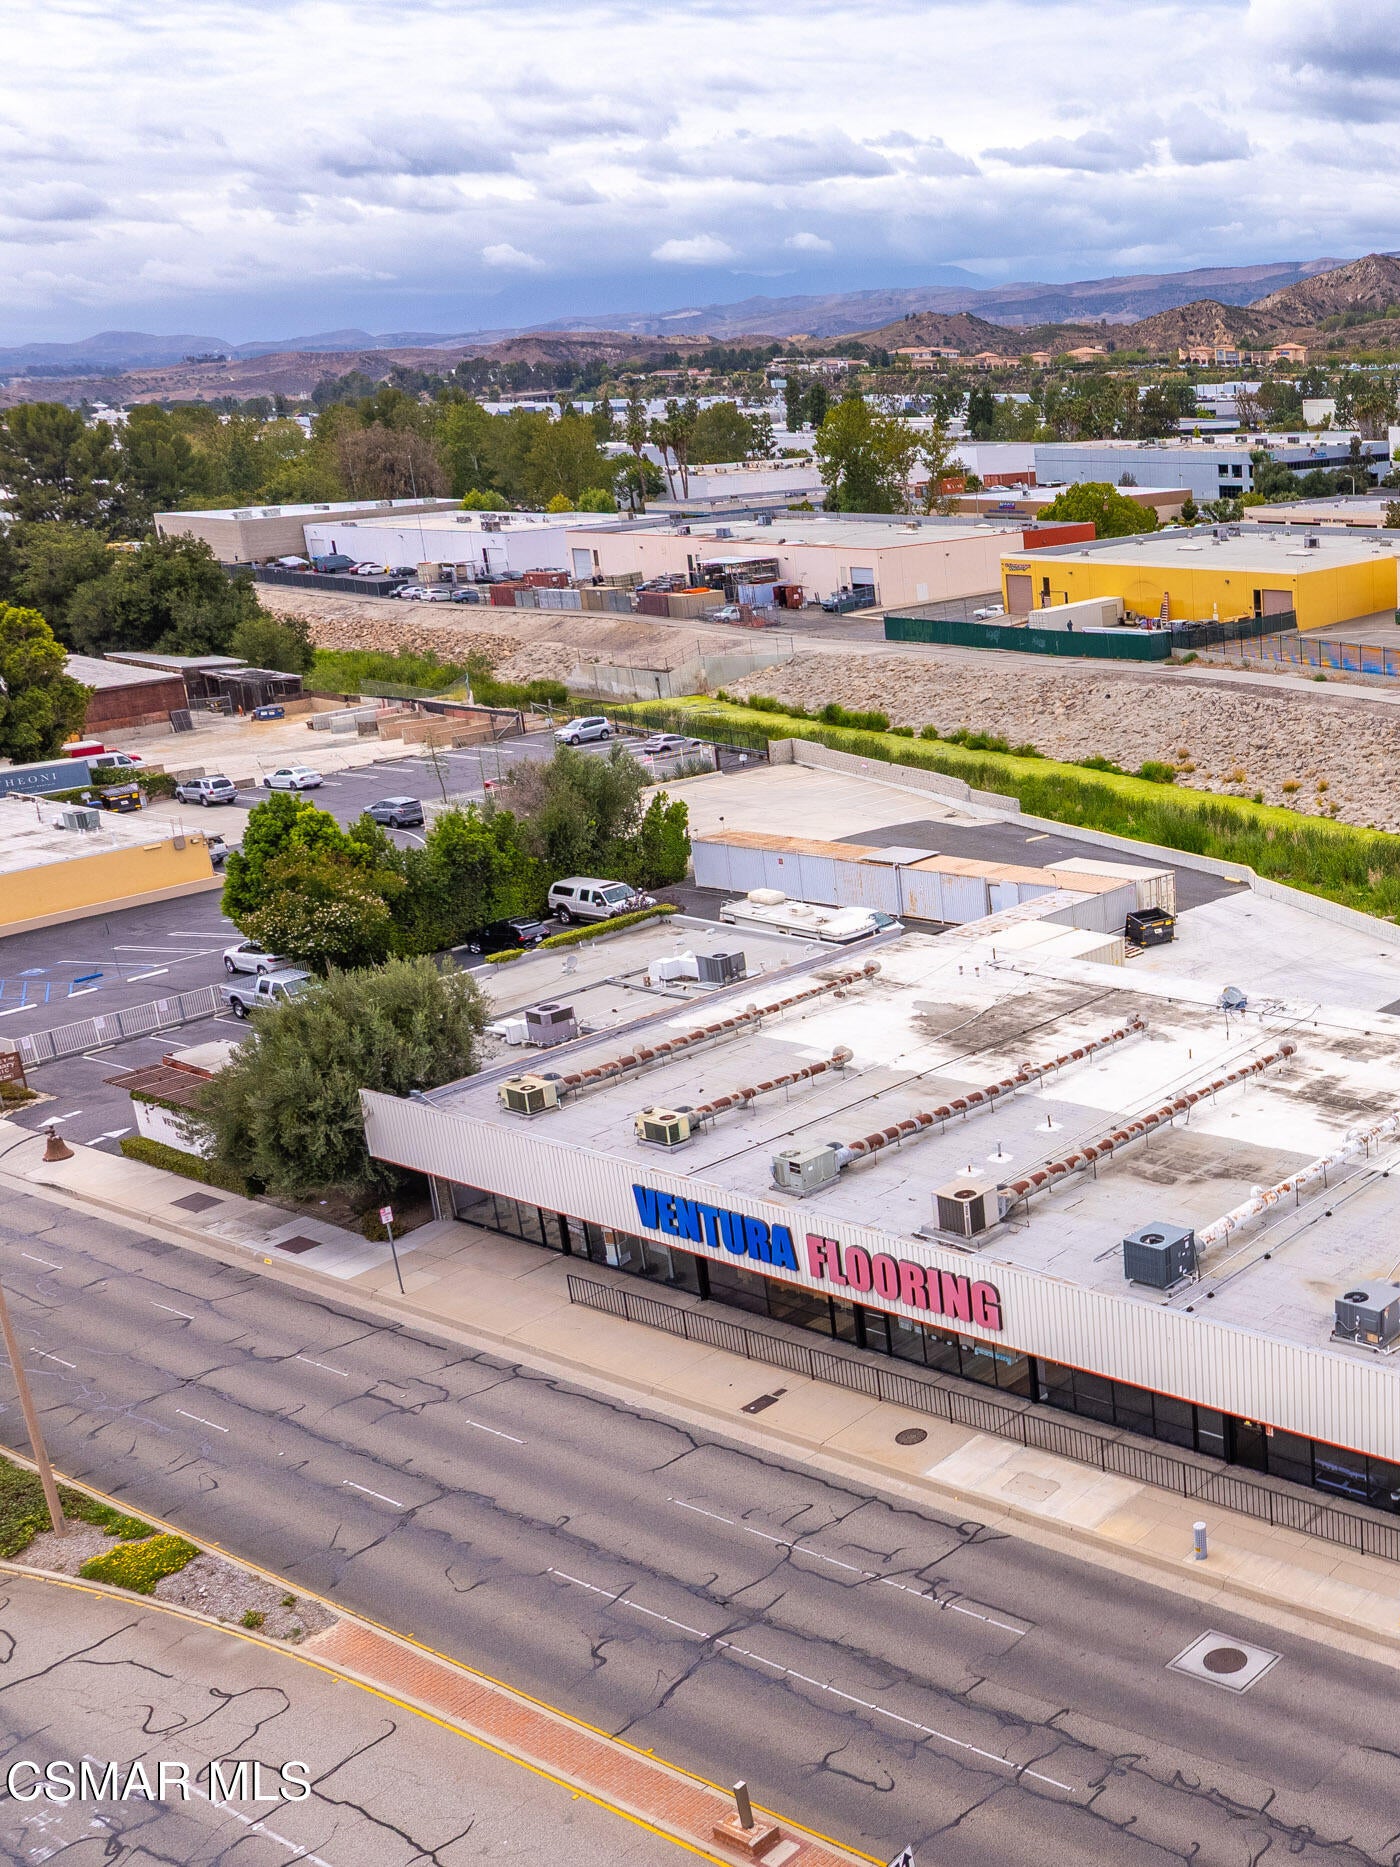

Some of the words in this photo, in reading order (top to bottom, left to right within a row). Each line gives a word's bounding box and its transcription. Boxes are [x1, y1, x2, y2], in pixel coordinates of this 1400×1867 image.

[0, 772, 57, 787] HEONI
[632, 1183, 800, 1272] VENTURA
[806, 1233, 1003, 1331] FLOORING
